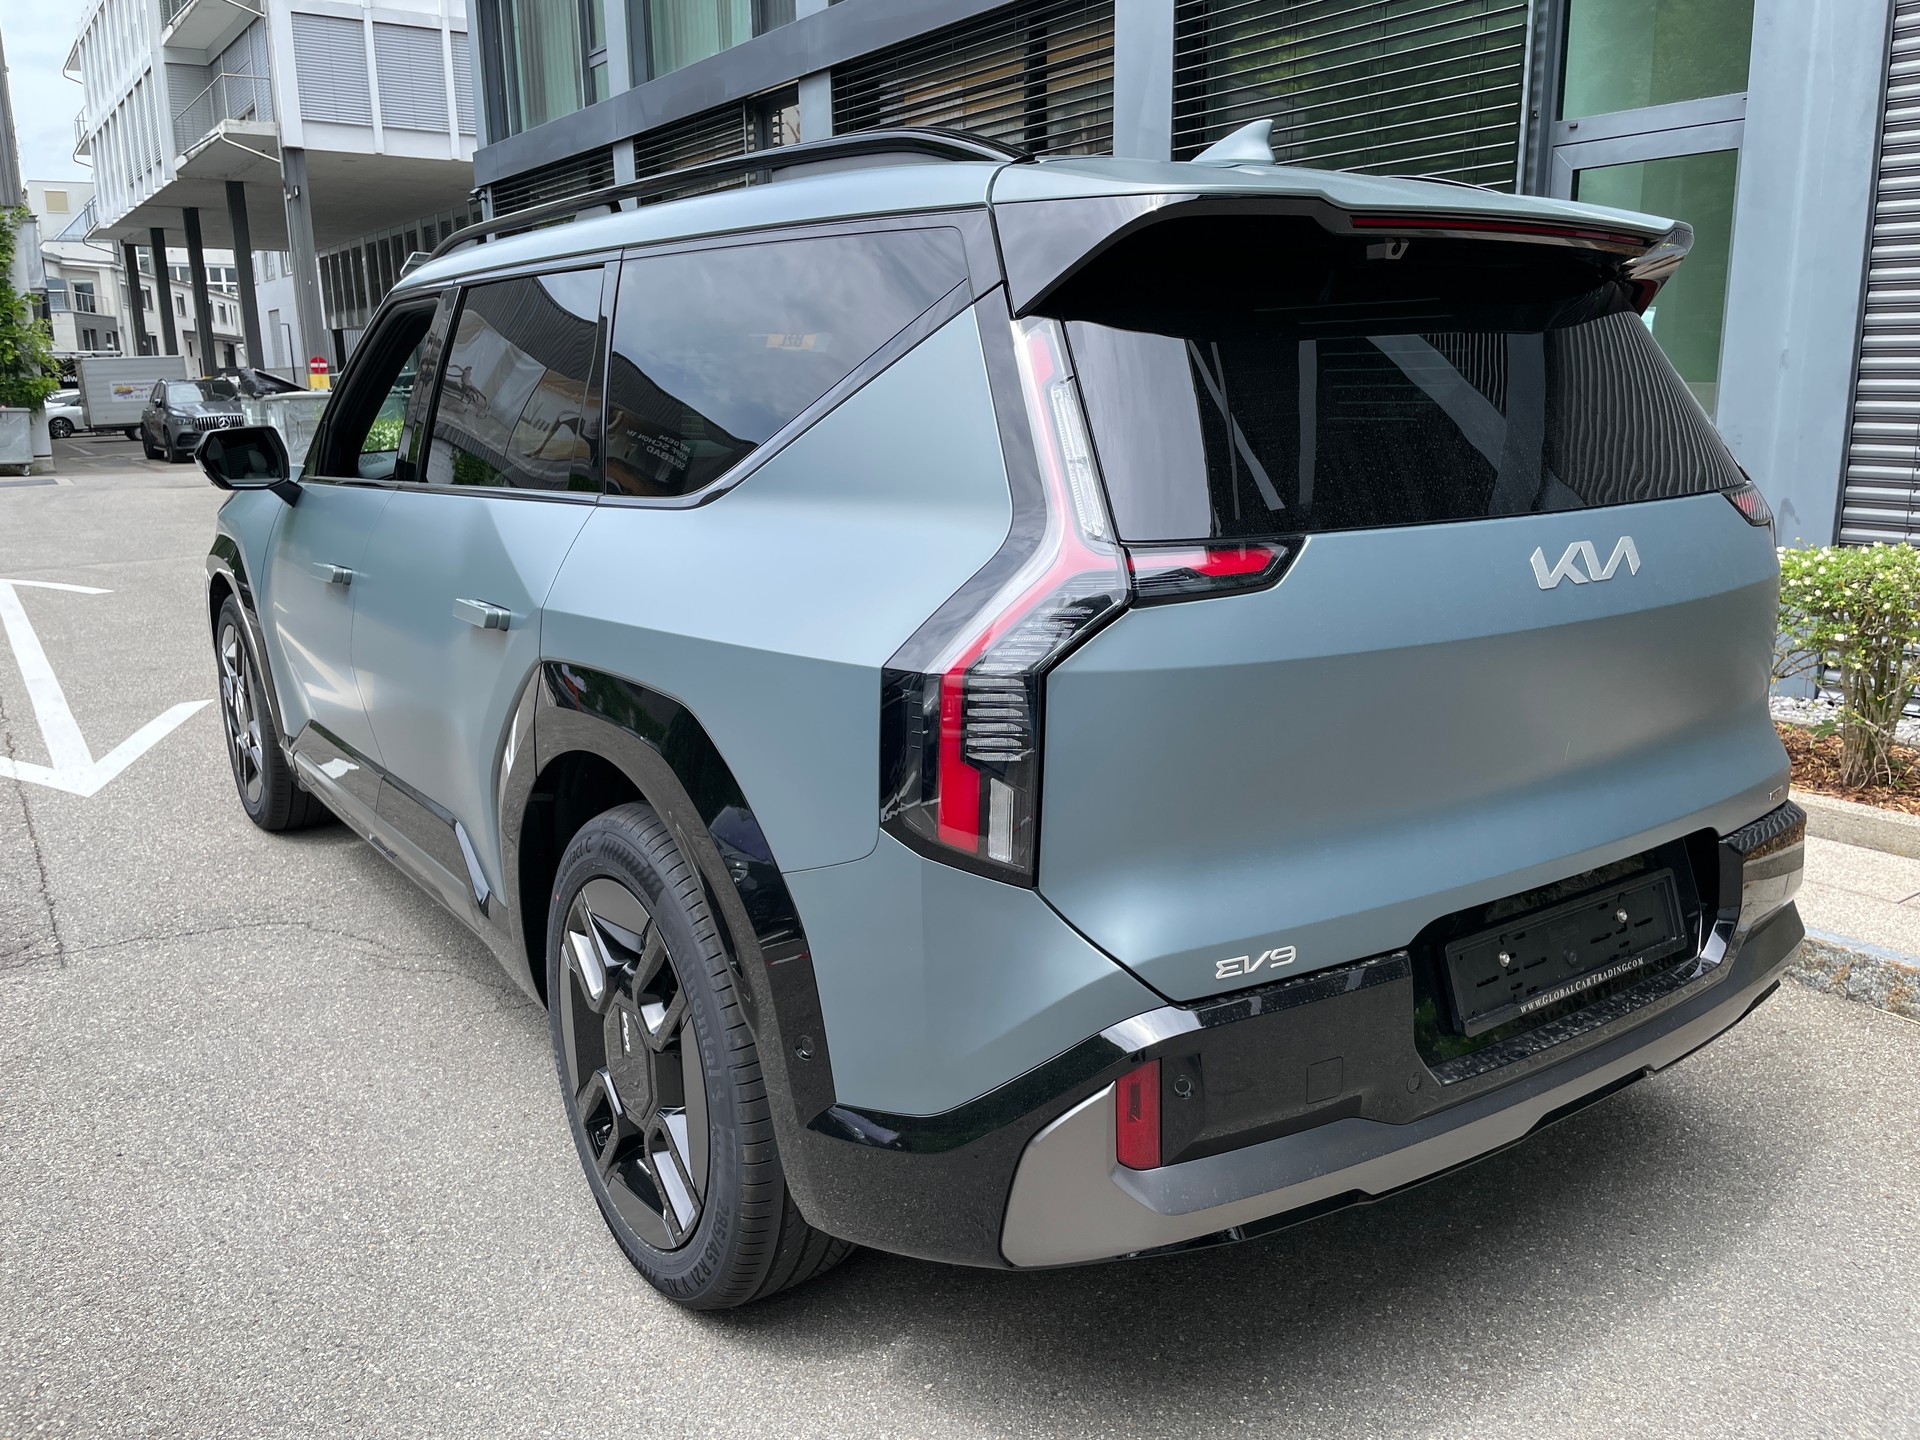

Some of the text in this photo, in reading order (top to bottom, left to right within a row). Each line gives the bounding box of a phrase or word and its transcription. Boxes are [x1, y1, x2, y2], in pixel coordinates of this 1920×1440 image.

[1529, 535, 1641, 590] KIA
[1215, 945, 1297, 980] EV9
[664, 1205, 731, 1296] 285/45 R21 V XL
